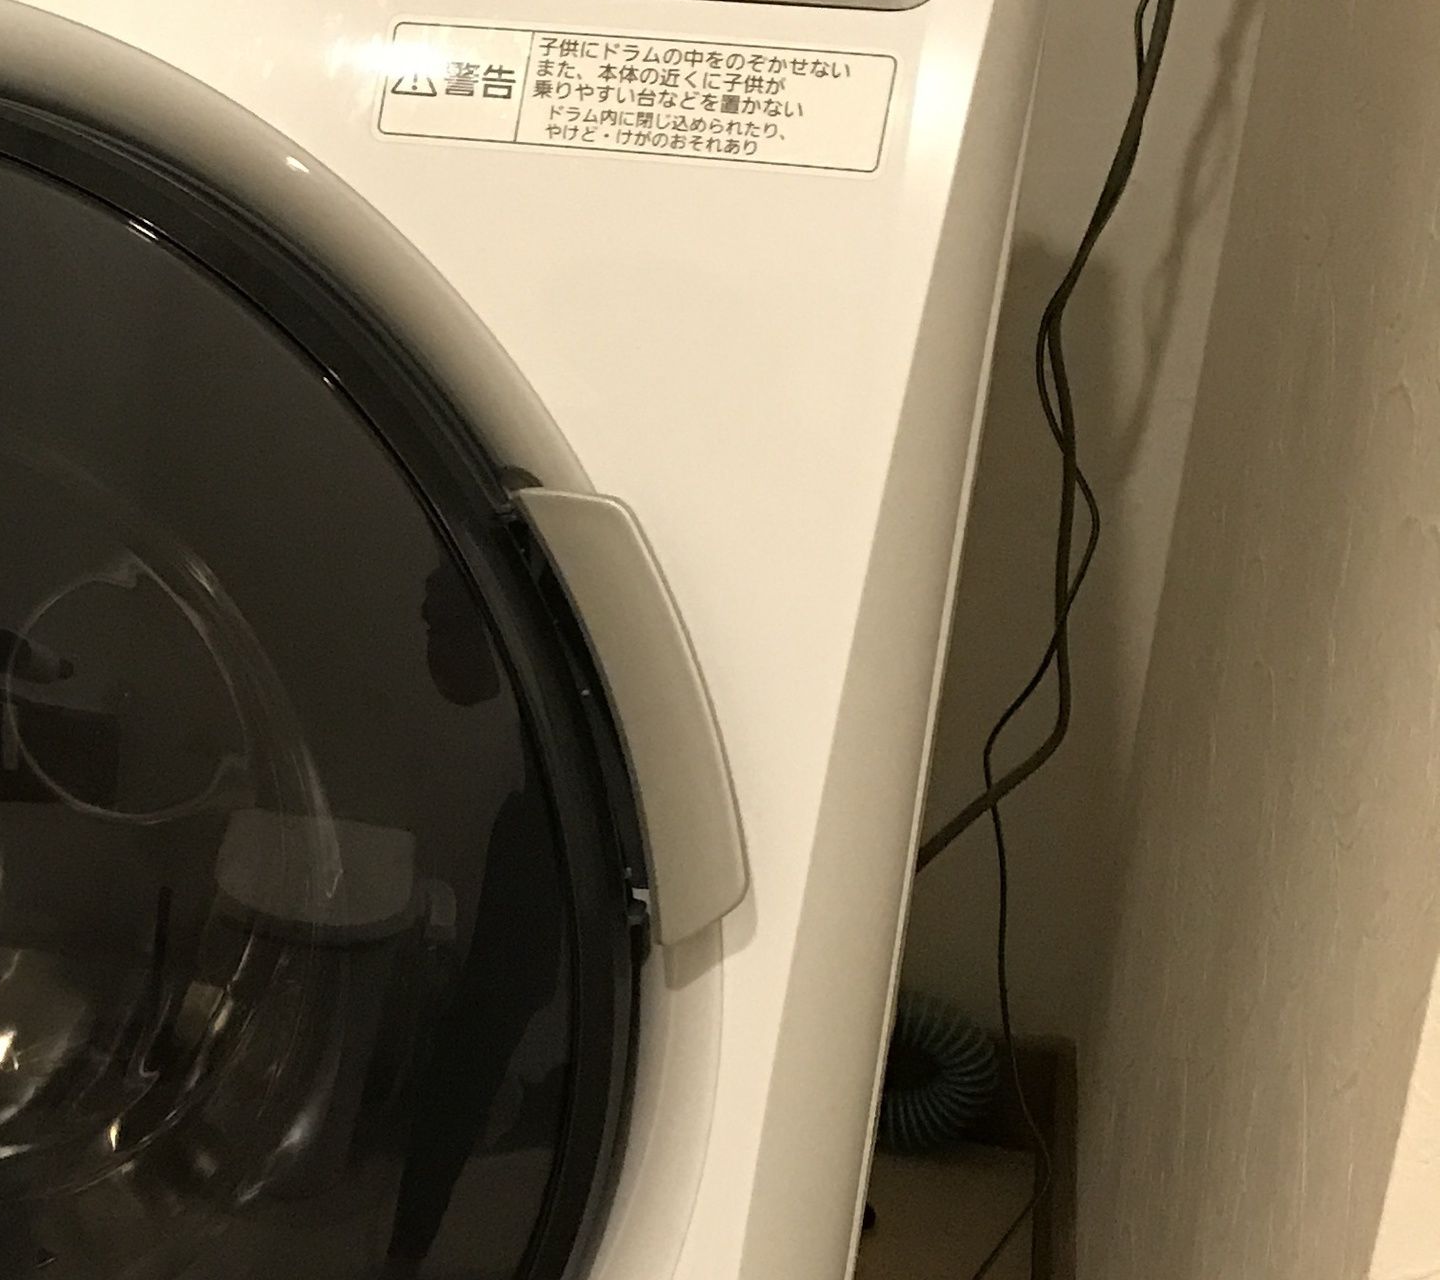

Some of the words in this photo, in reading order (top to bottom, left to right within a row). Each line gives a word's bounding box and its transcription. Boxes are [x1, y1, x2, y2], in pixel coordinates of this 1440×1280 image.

[538, 37, 851, 79] 子供にドラムの中をのぞかせない
[536, 59, 786, 96] また、本体の近くに子供が
[545, 124, 758, 156] やけど・けがのおそれあり
